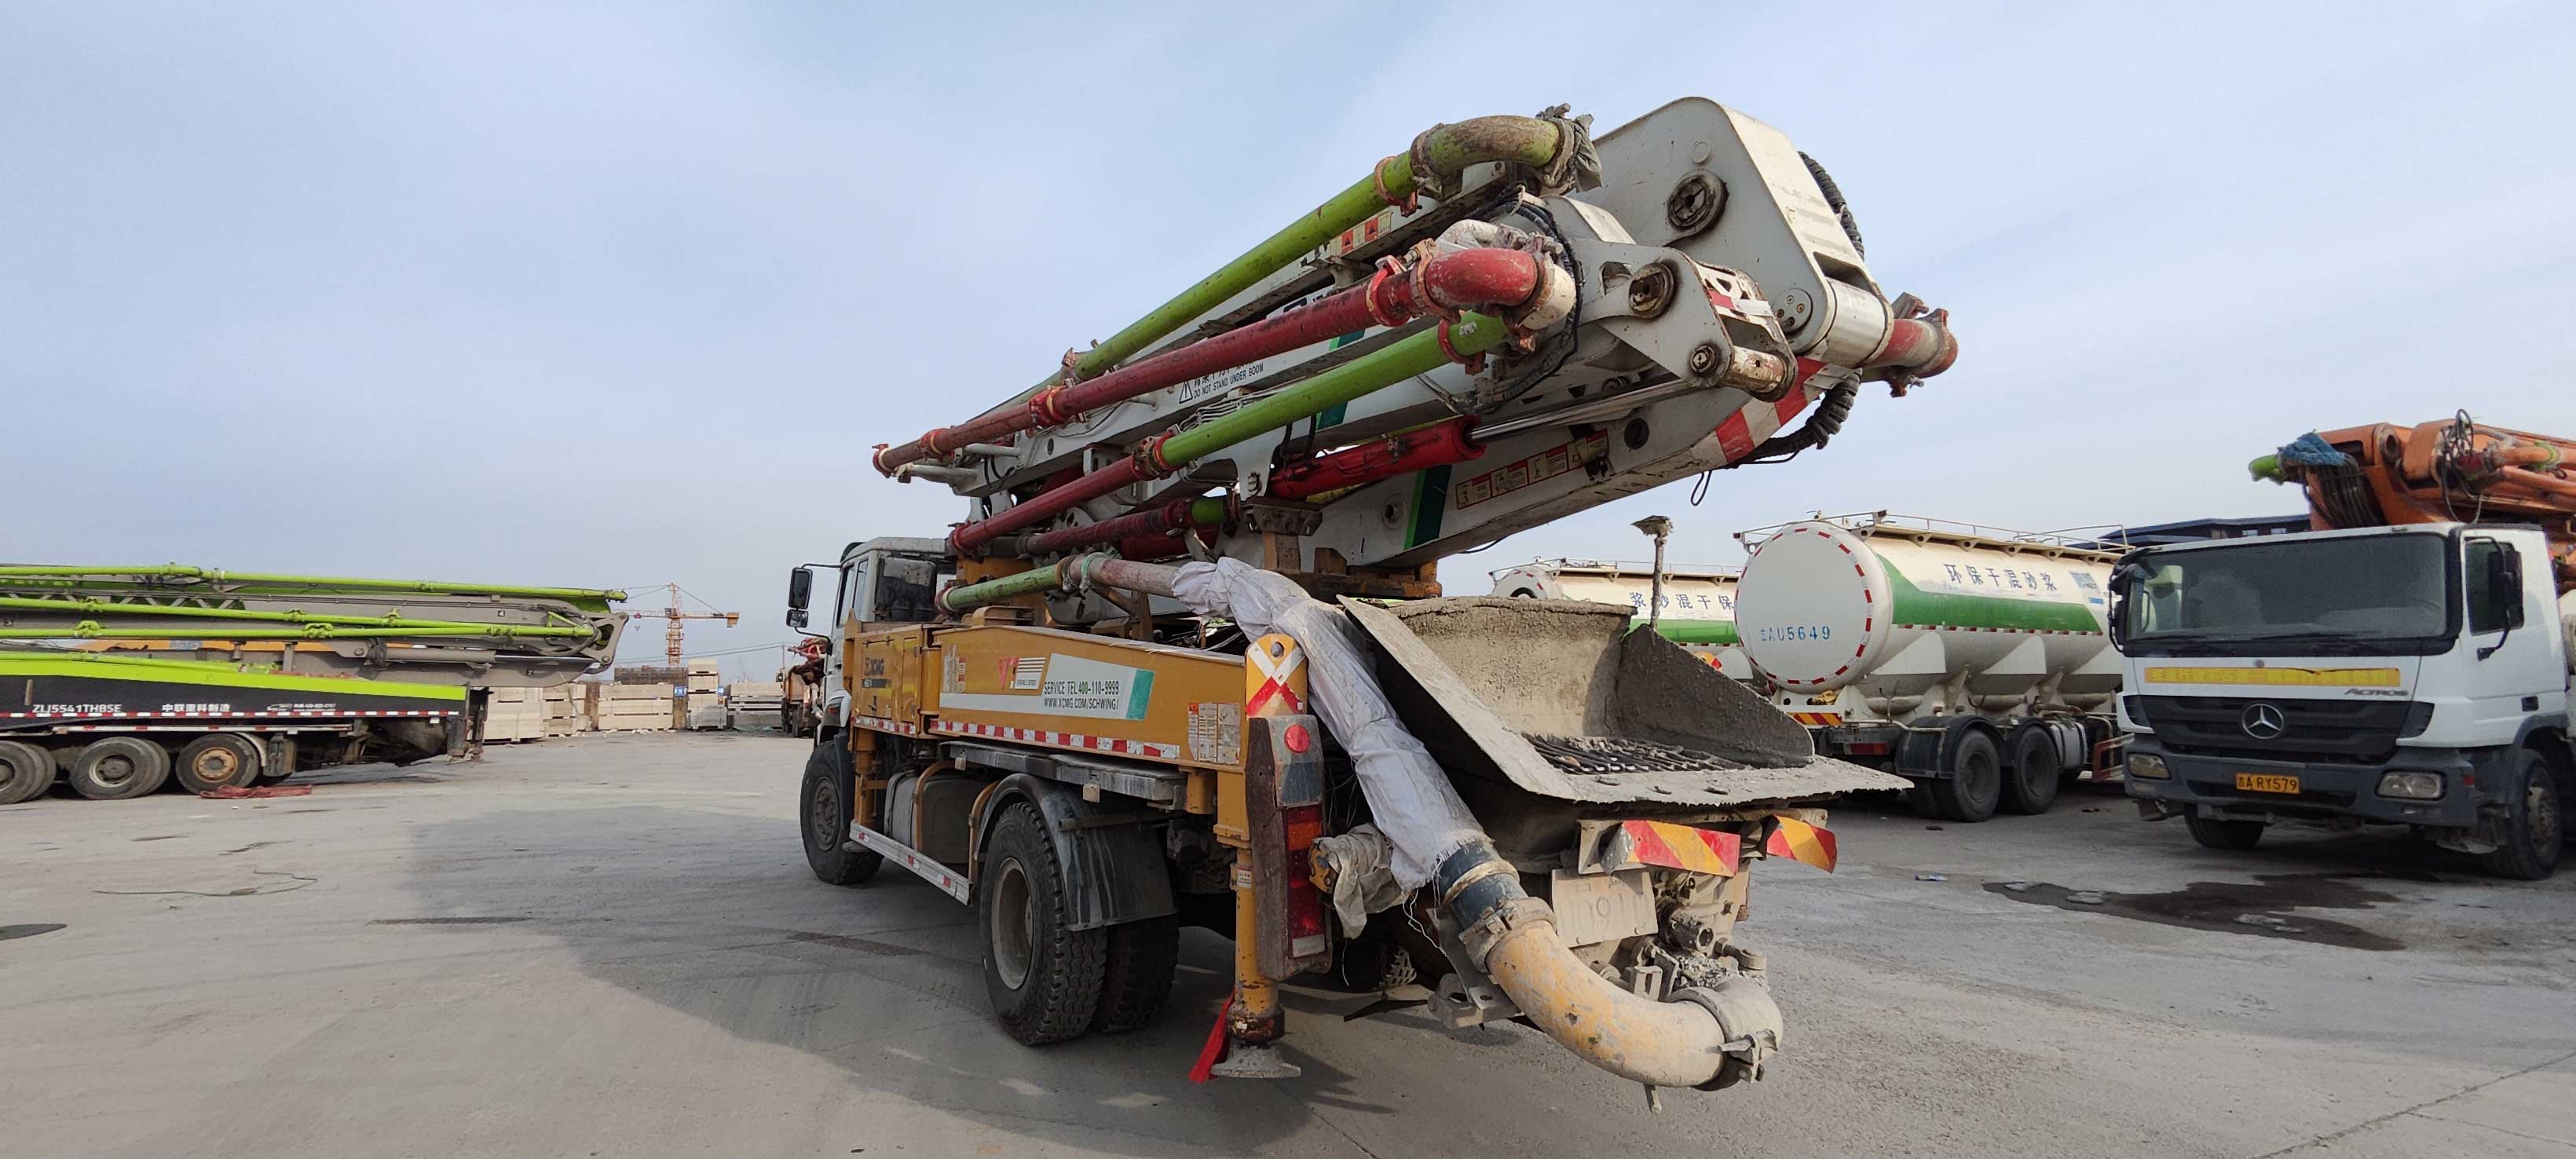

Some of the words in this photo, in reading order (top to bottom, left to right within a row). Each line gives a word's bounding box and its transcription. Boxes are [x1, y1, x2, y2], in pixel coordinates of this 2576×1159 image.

[1194, 388, 1201, 399] DO
[1202, 384, 1212, 395] NOT
[1213, 378, 1228, 391] STAND
[1230, 370, 1247, 385] UNDER
[1248, 362, 1264, 377] BOOM
[1943, 563, 2058, 591] 环保干混砂浆
[1044, 681, 1065, 695] SERVICE
[162, 704, 230, 713] 中联重科制造
